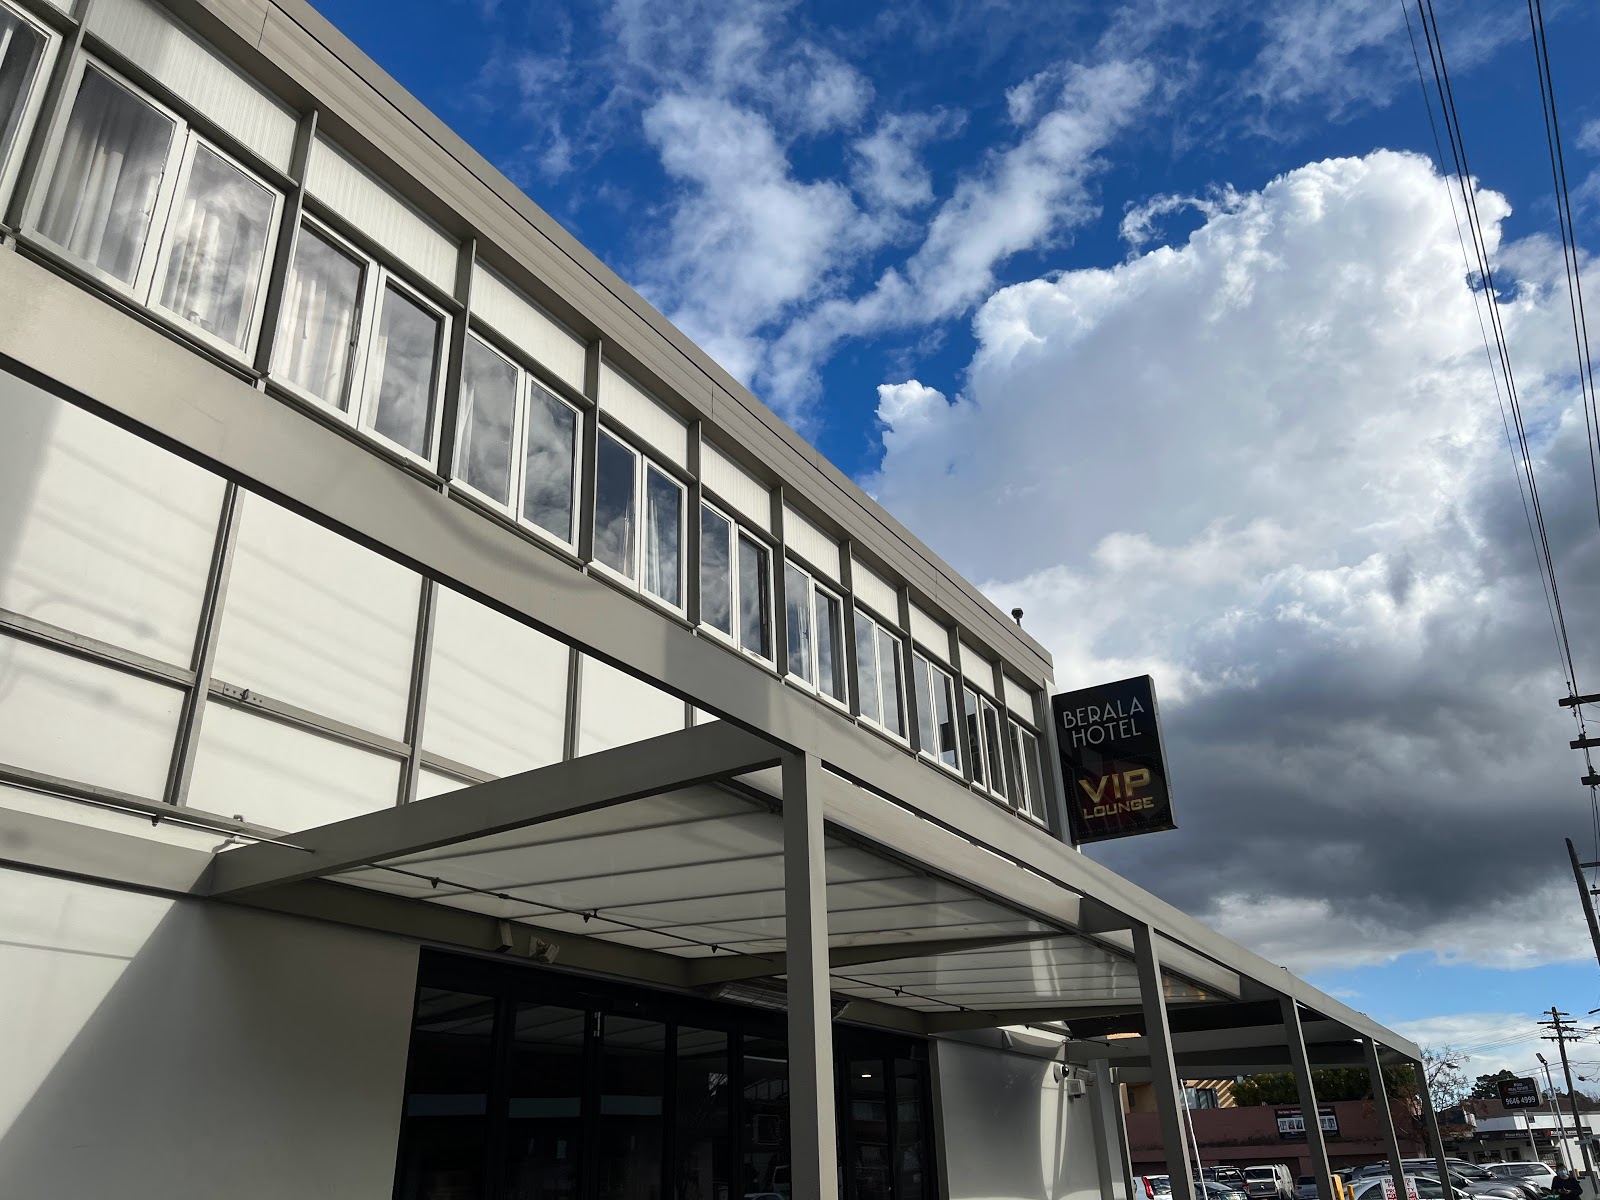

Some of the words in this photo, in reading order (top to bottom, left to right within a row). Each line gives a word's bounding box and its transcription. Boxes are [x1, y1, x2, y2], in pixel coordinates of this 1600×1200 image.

[1063, 696, 1145, 729] BERALA
[1072, 718, 1142, 748] HOTEL
[1079, 768, 1151, 804] VIP
[1083, 796, 1155, 819] LOUNGE
[1505, 1097, 1520, 1105] 9646
[1520, 1096, 1536, 1104] 4999
